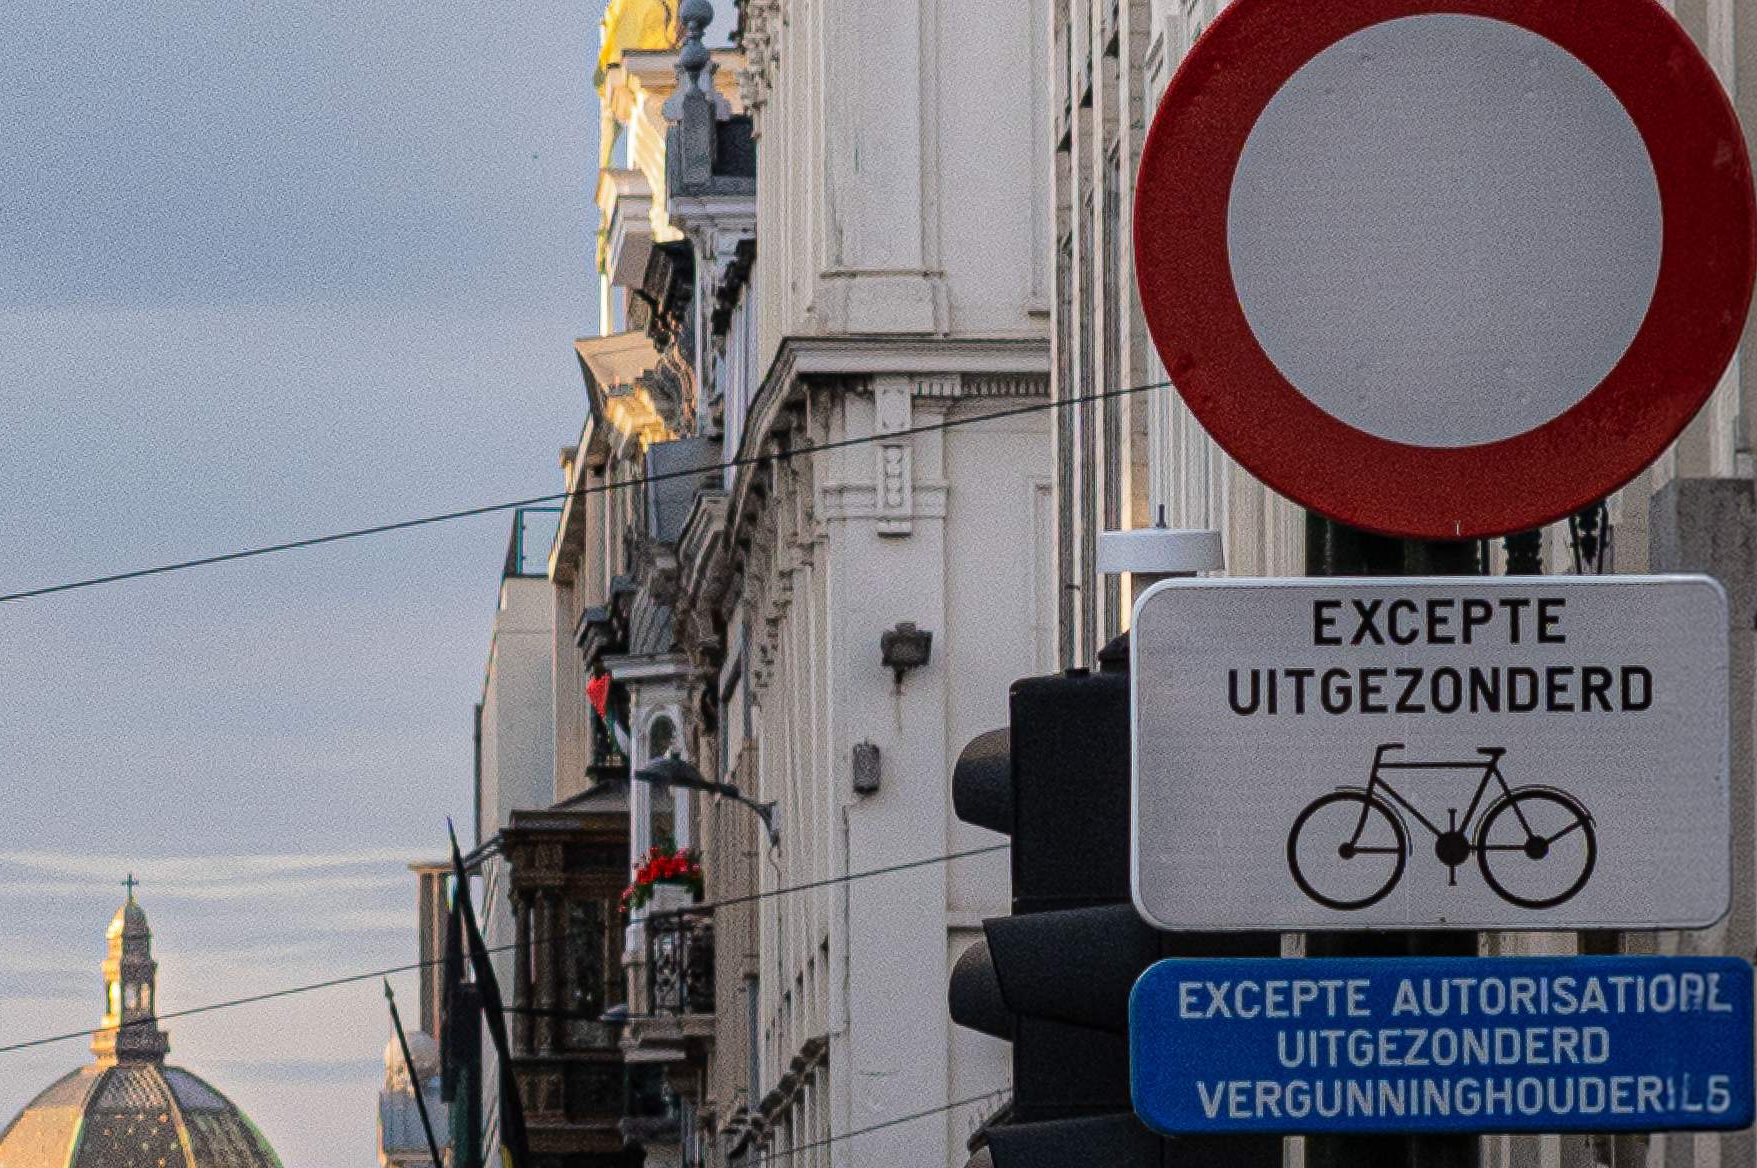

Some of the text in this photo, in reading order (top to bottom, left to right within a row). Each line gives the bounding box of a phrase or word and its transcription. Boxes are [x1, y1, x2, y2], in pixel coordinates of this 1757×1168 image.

[1313, 597, 1567, 646] EXCEPTE
[1227, 666, 1654, 716] UITGEZONDERD
[1178, 979, 1371, 1019] EXCEPTE
[1277, 1026, 1611, 1068] UITGEZONDERD
